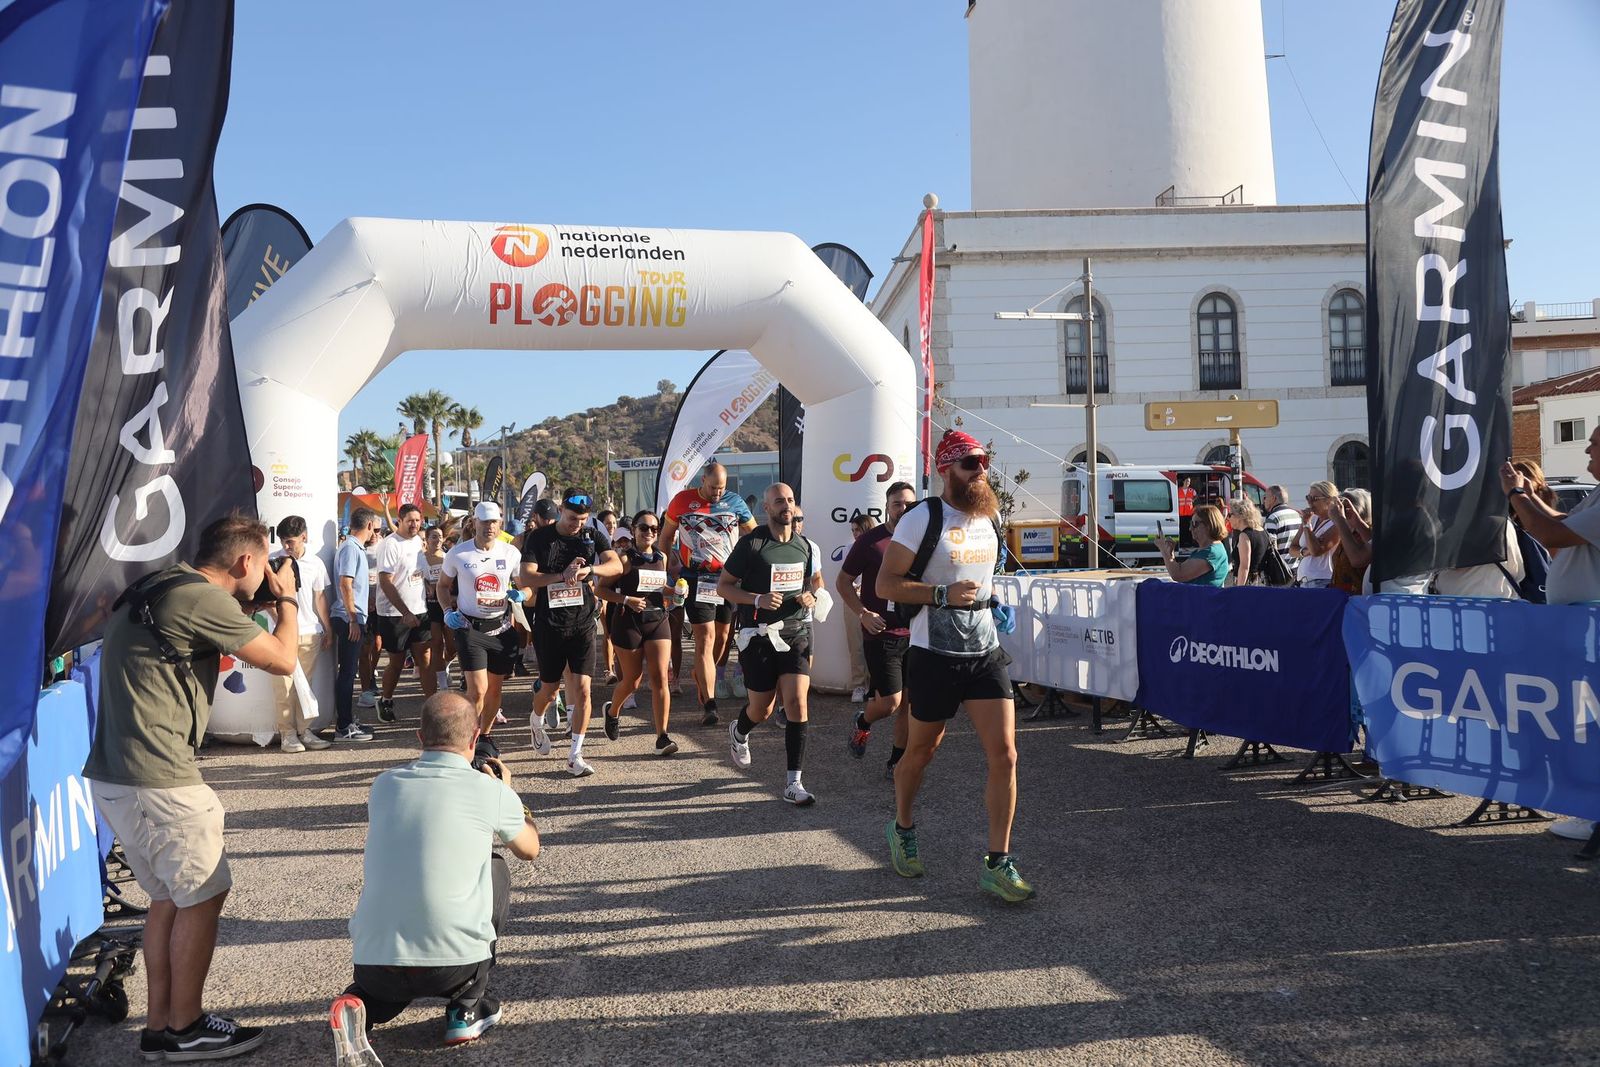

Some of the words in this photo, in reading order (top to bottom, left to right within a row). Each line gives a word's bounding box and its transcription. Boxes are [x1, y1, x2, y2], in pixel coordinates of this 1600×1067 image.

[559, 231, 651, 244] nationale
[561, 244, 686, 261] nederlanden
[1414, 30, 1481, 491] GARMIN
[638, 270, 686, 286] TOUR
[489, 282, 687, 328] PLOGGING
[682, 431, 706, 459] nationale
[687, 428, 719, 463] nederlanden
[273, 476, 301, 485] Consejo
[273, 484, 303, 492] Superior
[831, 507, 888, 523] GAR
[478, 579, 498, 588] PONLE
[775, 572, 801, 581] 24380
[551, 590, 579, 599] 24937
[1084, 628, 1115, 645] AETIB
[1190, 641, 1279, 672] DECATHLON
